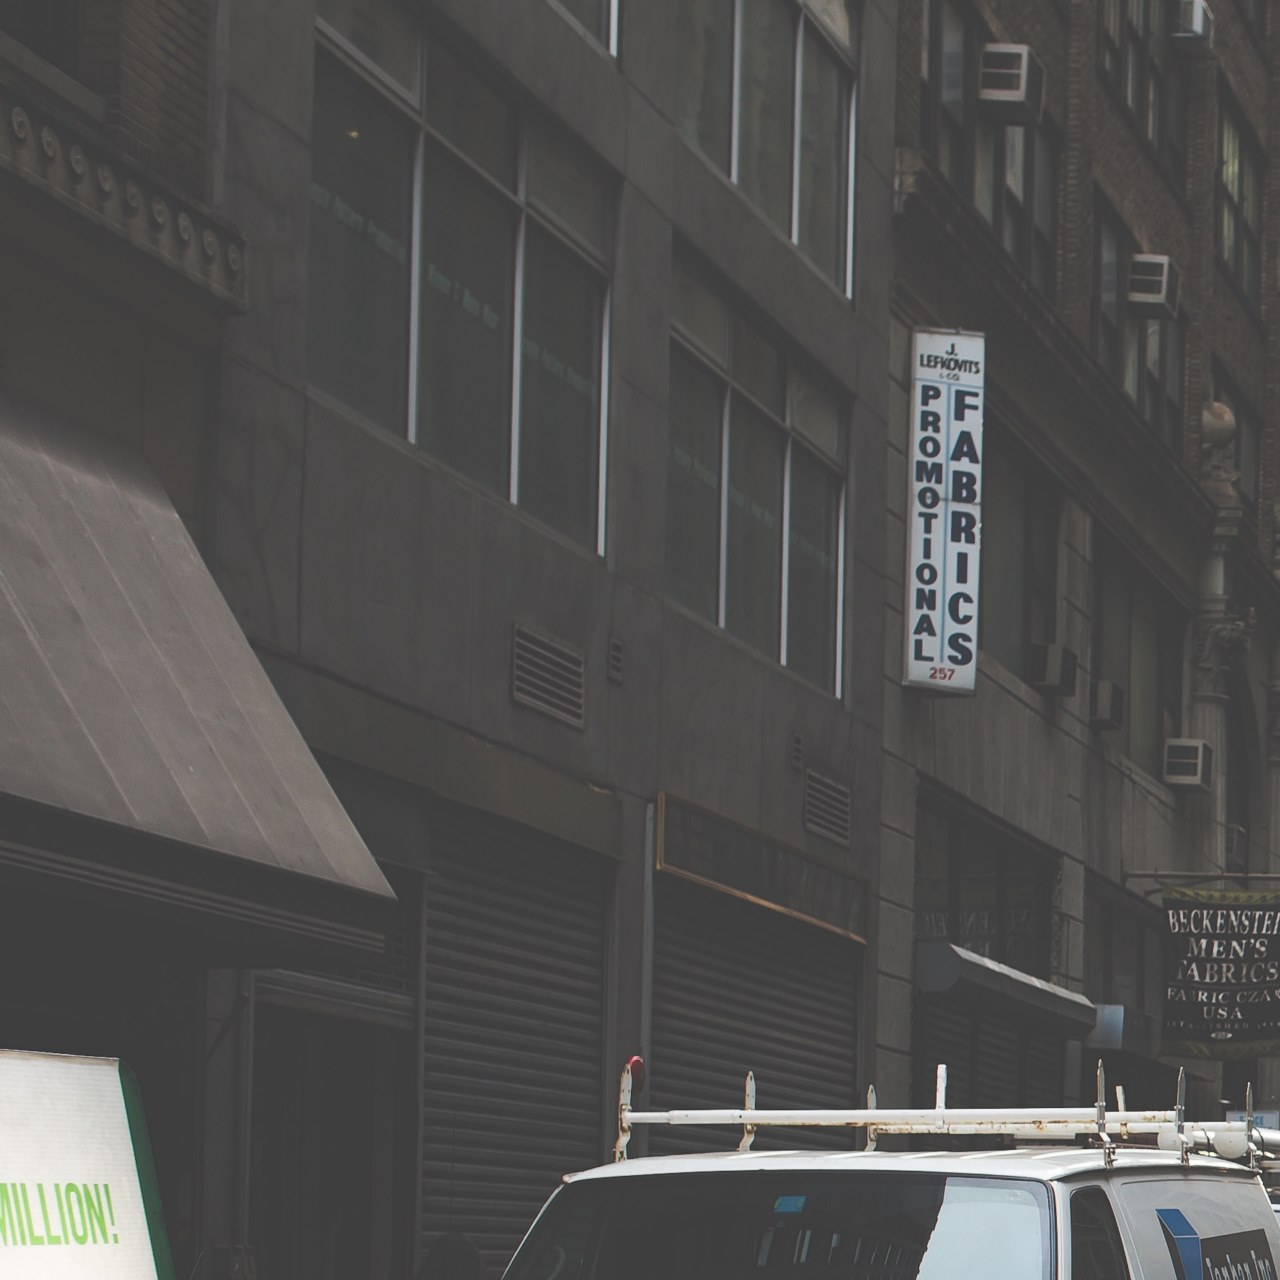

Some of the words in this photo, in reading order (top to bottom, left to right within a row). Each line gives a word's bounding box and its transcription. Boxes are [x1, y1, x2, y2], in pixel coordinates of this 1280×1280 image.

[919, 353, 981, 375] LEFKOVITS
[914, 384, 943, 662] PROMOTIONAL
[947, 389, 981, 667] FABRICS
[929, 667, 956, 682] 257
[1187, 937, 1269, 959] MEN'S
[1175, 960, 1280, 984] FABRICS
[1203, 1005, 1243, 1019] USA
